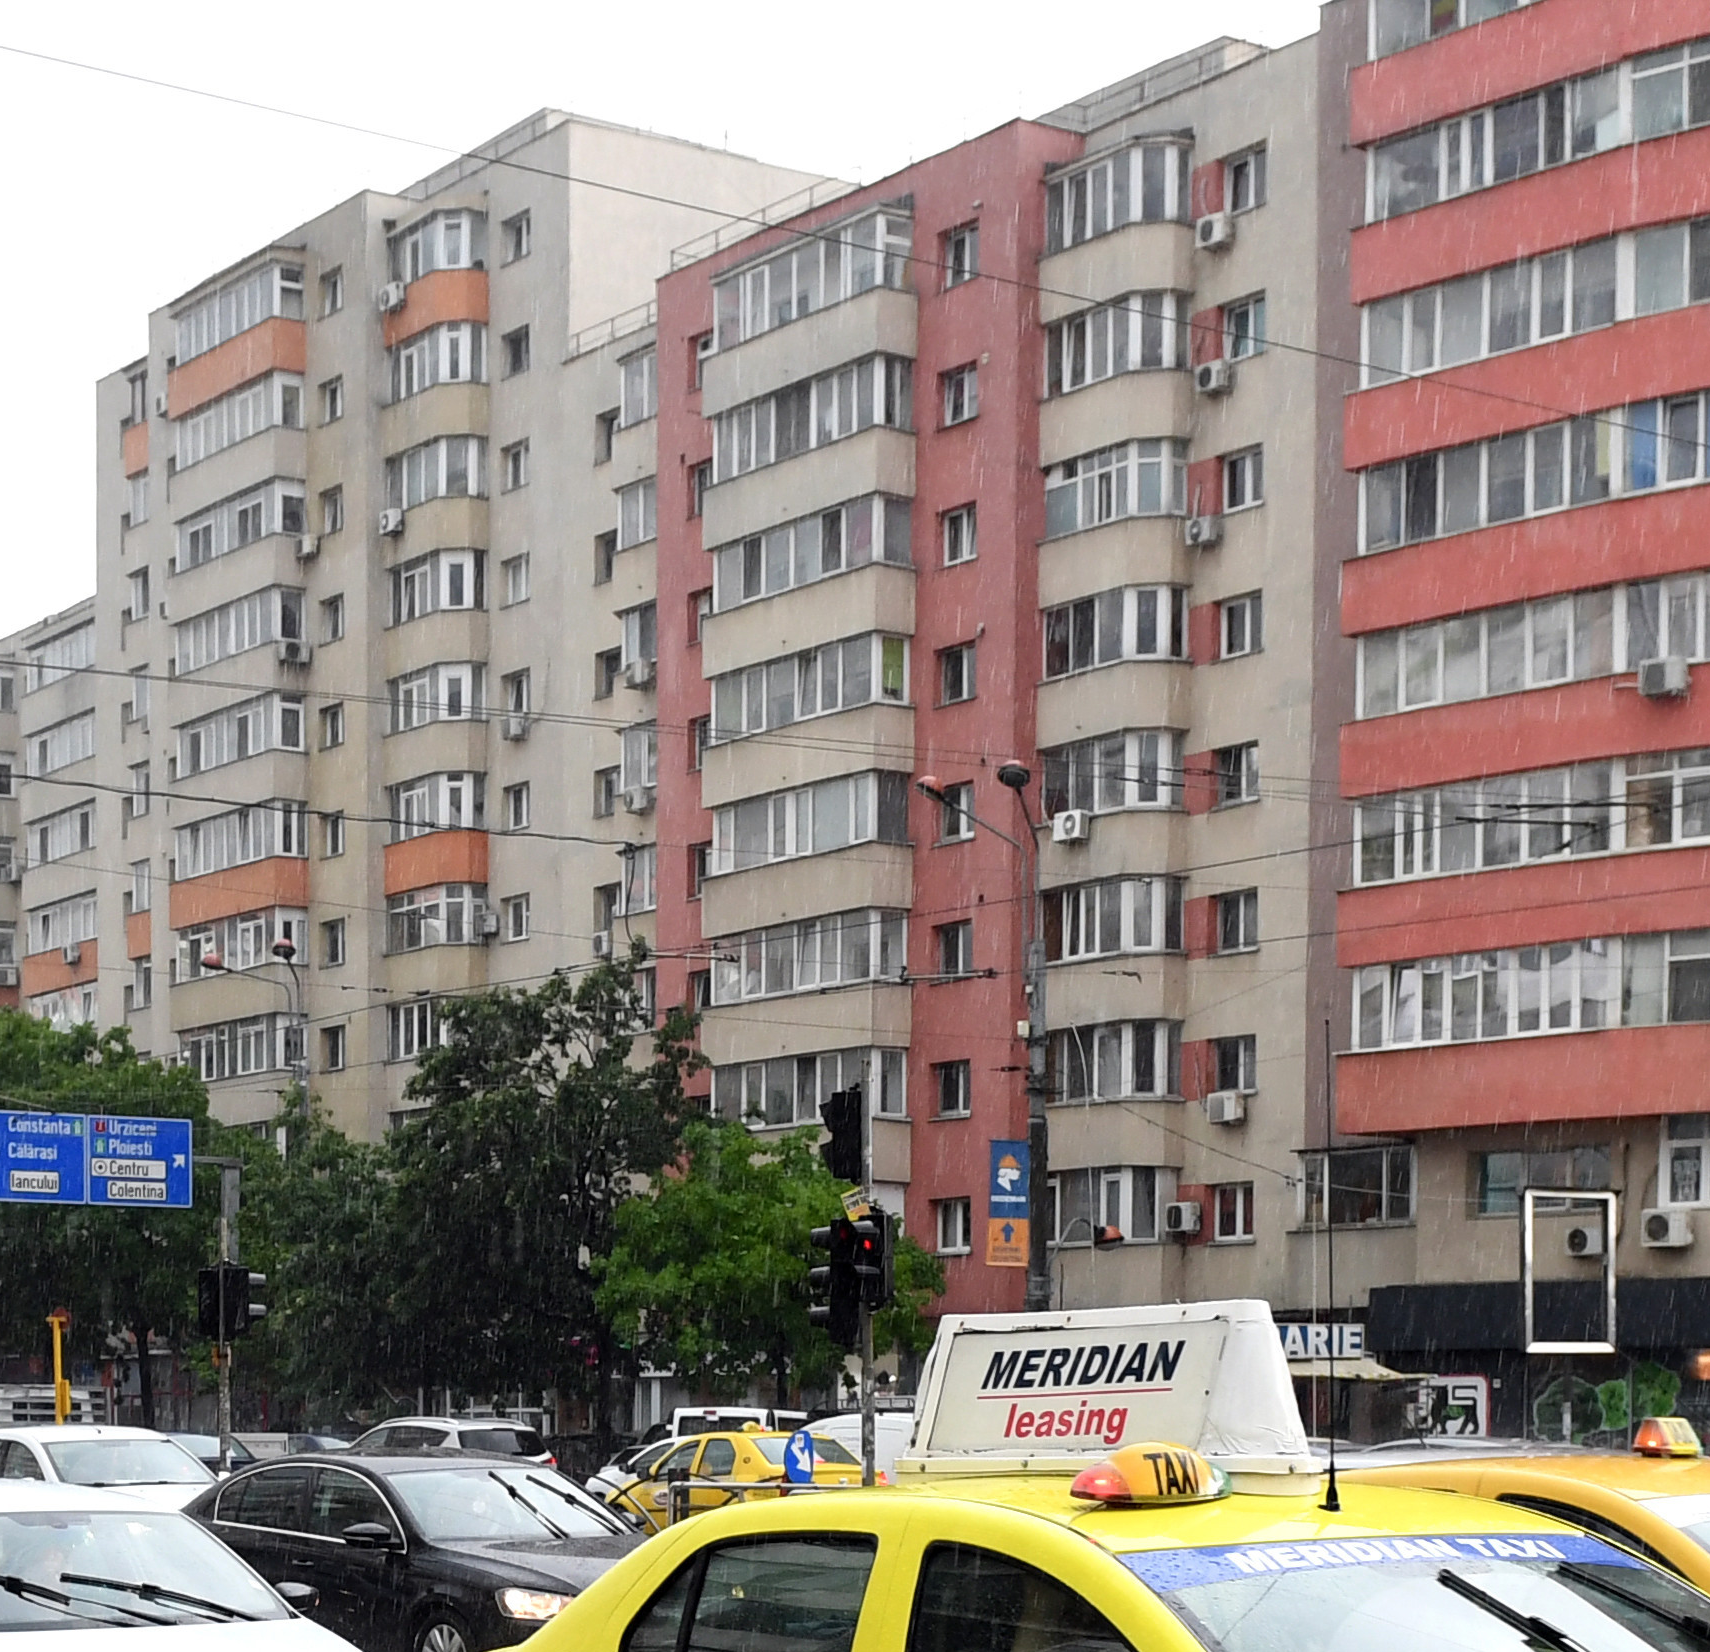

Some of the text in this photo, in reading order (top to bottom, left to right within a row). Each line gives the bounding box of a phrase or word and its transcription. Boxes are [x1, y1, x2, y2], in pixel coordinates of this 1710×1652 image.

[109, 1120, 157, 1137] Urziceni
[11, 1175, 58, 1190] Iancului
[109, 1161, 149, 1177] Centru
[109, 1182, 164, 1199] Colentina
[980, 1339, 1187, 1391] MERIDIAN
[1003, 1400, 1128, 1444] leasing
[1142, 1452, 1200, 1496] TAXI
[1224, 1537, 1567, 1574] MERIDIAN TAXI
